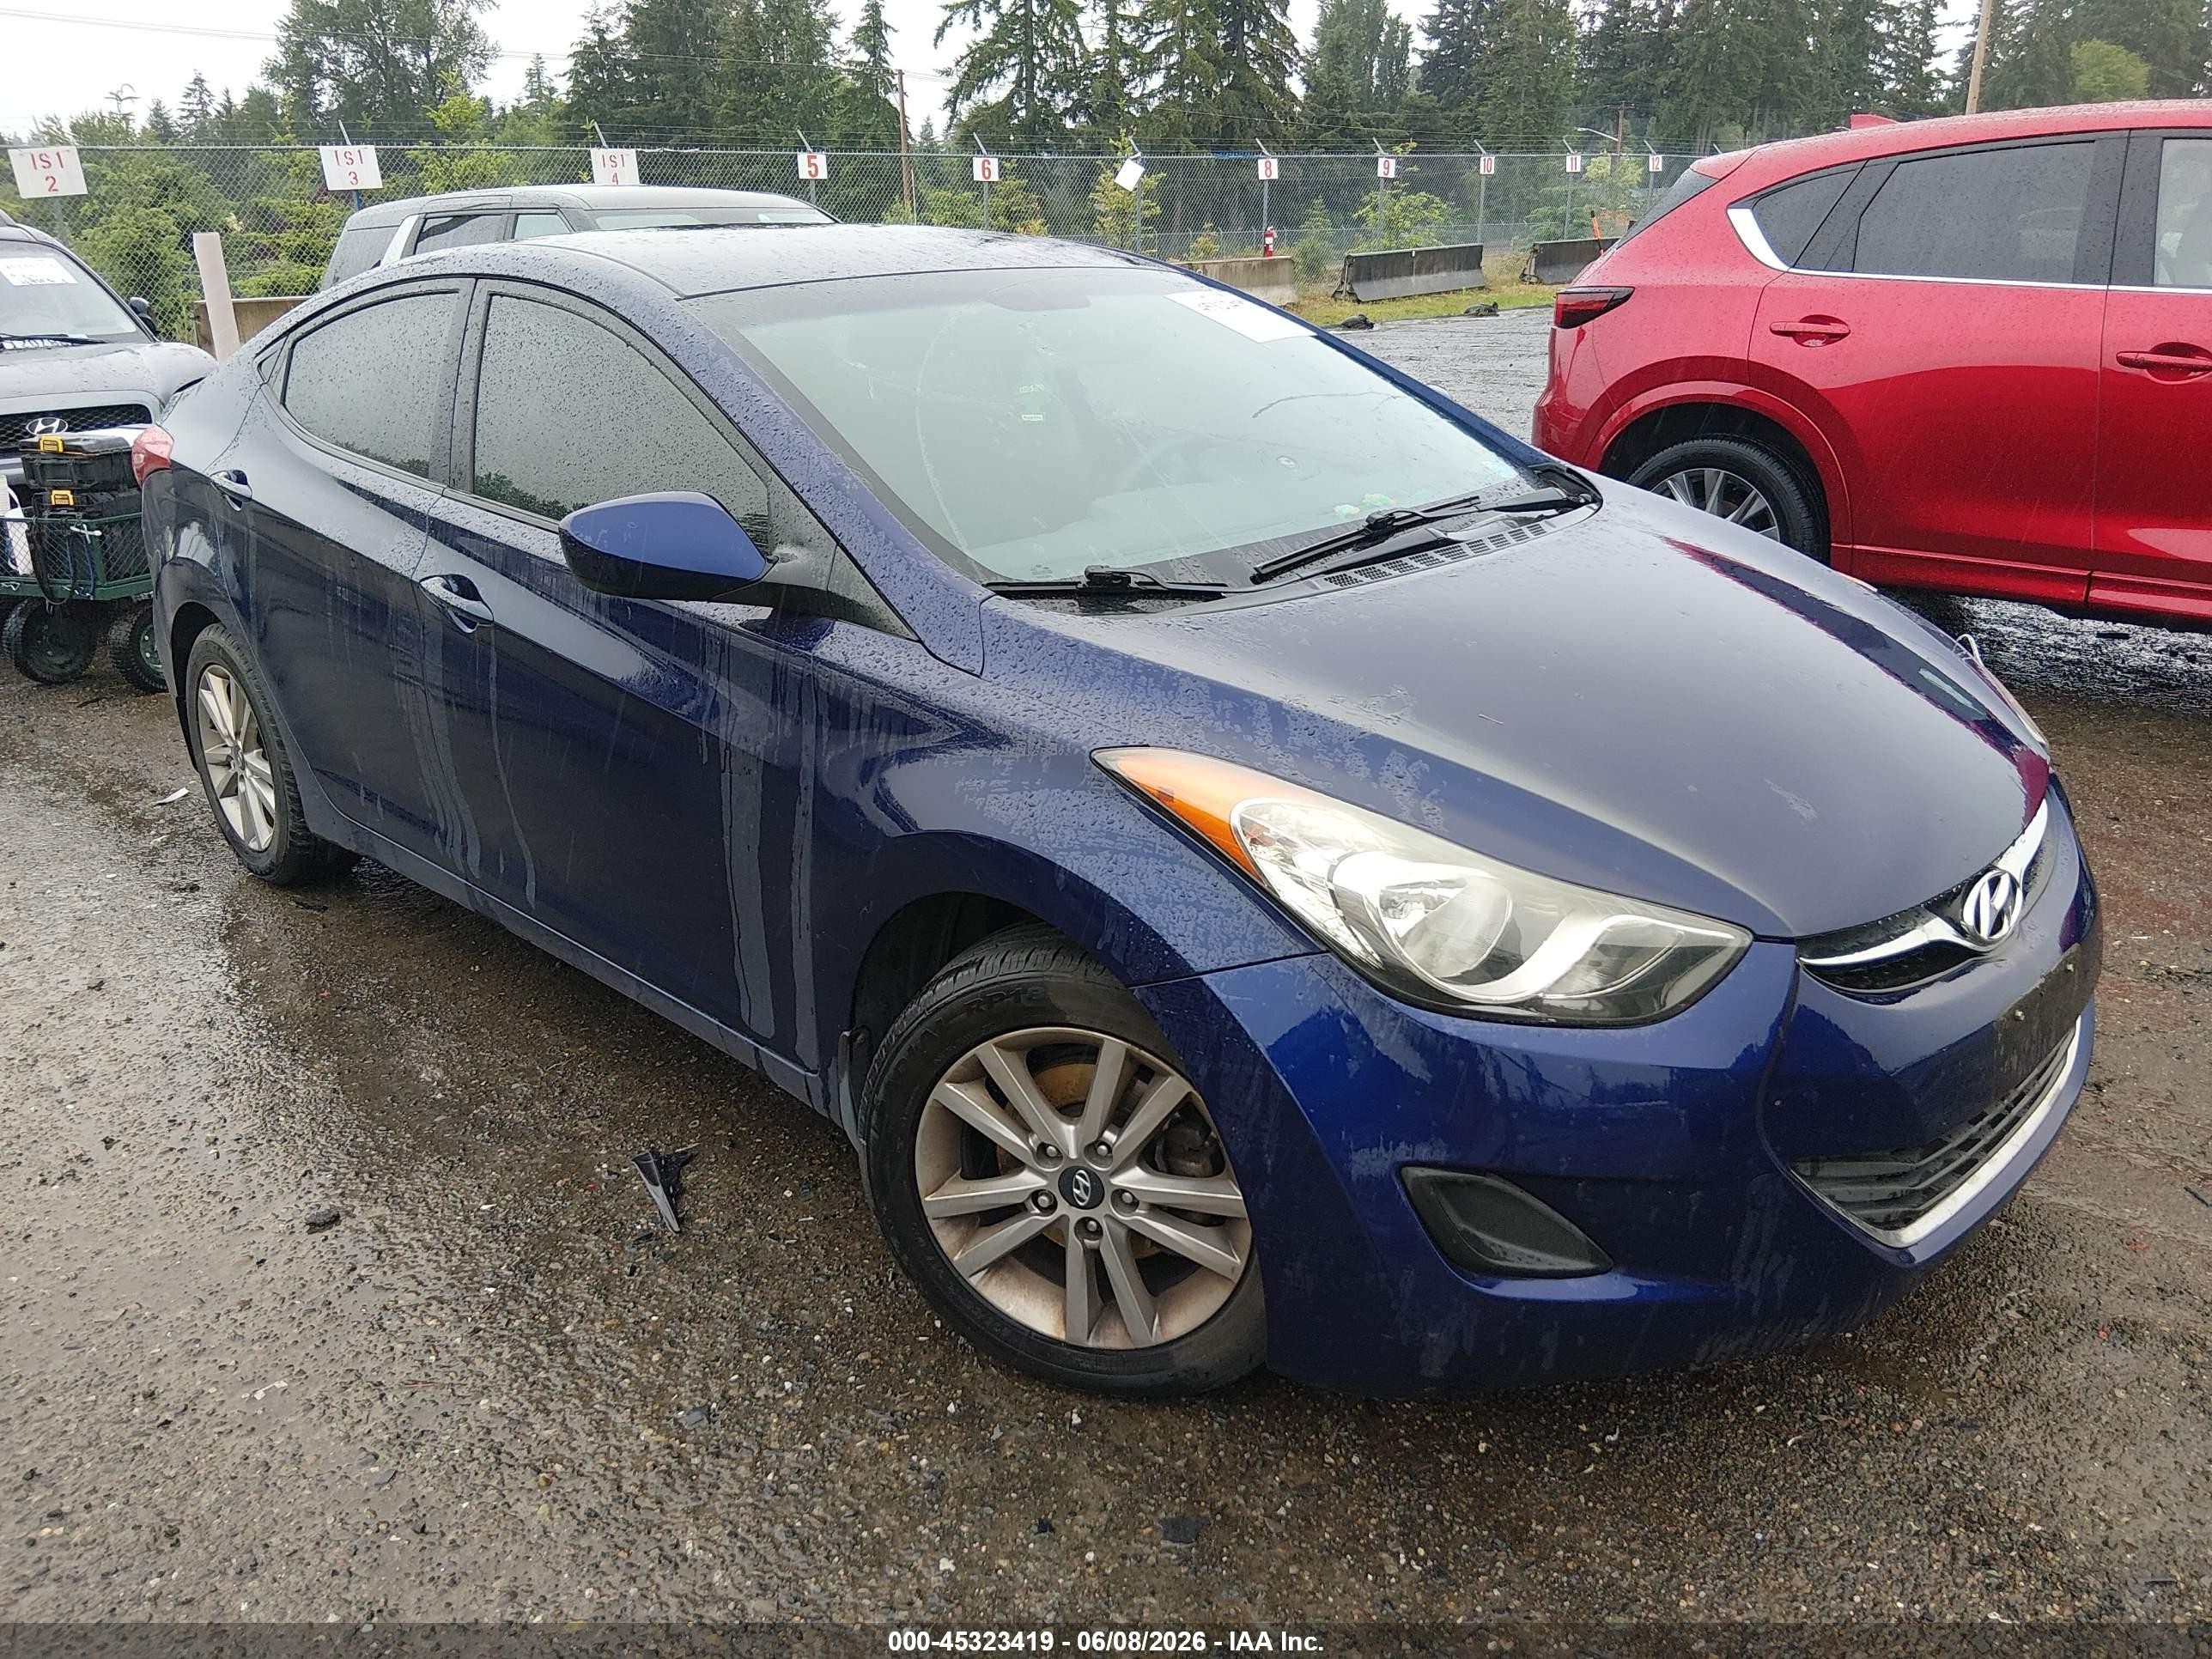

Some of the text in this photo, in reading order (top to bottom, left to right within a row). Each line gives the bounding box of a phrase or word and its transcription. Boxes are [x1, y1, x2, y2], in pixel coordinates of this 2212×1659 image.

[807, 155, 818, 178] 5
[981, 159, 992, 179] 6
[1265, 160, 1272, 178] 8
[1383, 160, 1389, 176] 9
[1483, 157, 1492, 173] 10
[1570, 156, 1577, 171] 11
[1652, 156, 1661, 170] 12
[46, 175, 59, 192] 2
[348, 171, 359, 185] 3
[611, 173, 619, 185] 4
